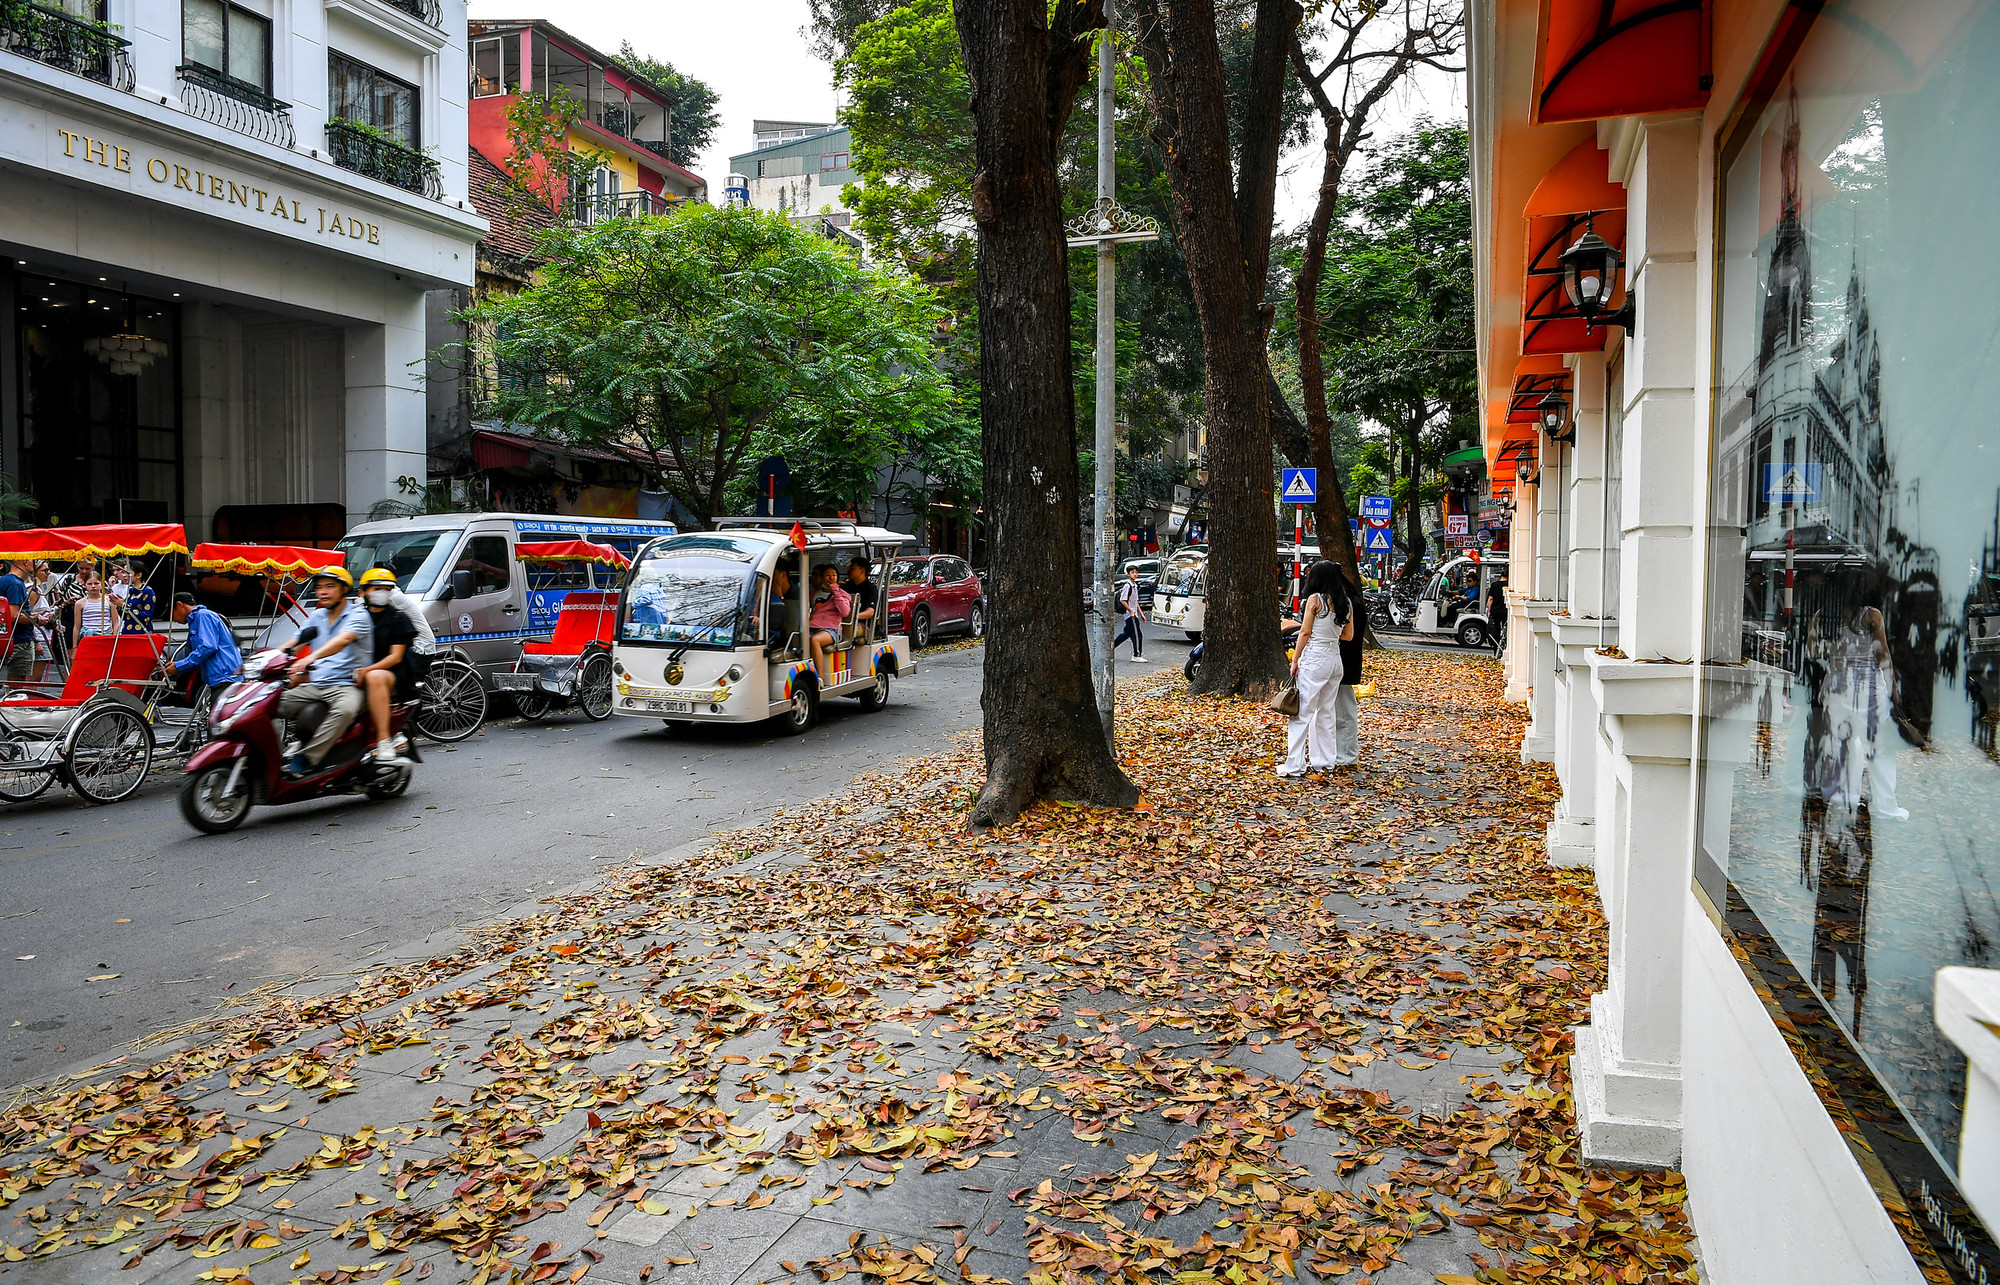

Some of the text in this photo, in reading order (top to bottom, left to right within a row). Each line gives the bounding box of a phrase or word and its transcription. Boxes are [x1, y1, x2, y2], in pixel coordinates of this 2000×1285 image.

[58, 129, 381, 245] THE ORIENTAL JADE
[398, 475, 417, 494] 92
[1455, 537, 1464, 547] 69
